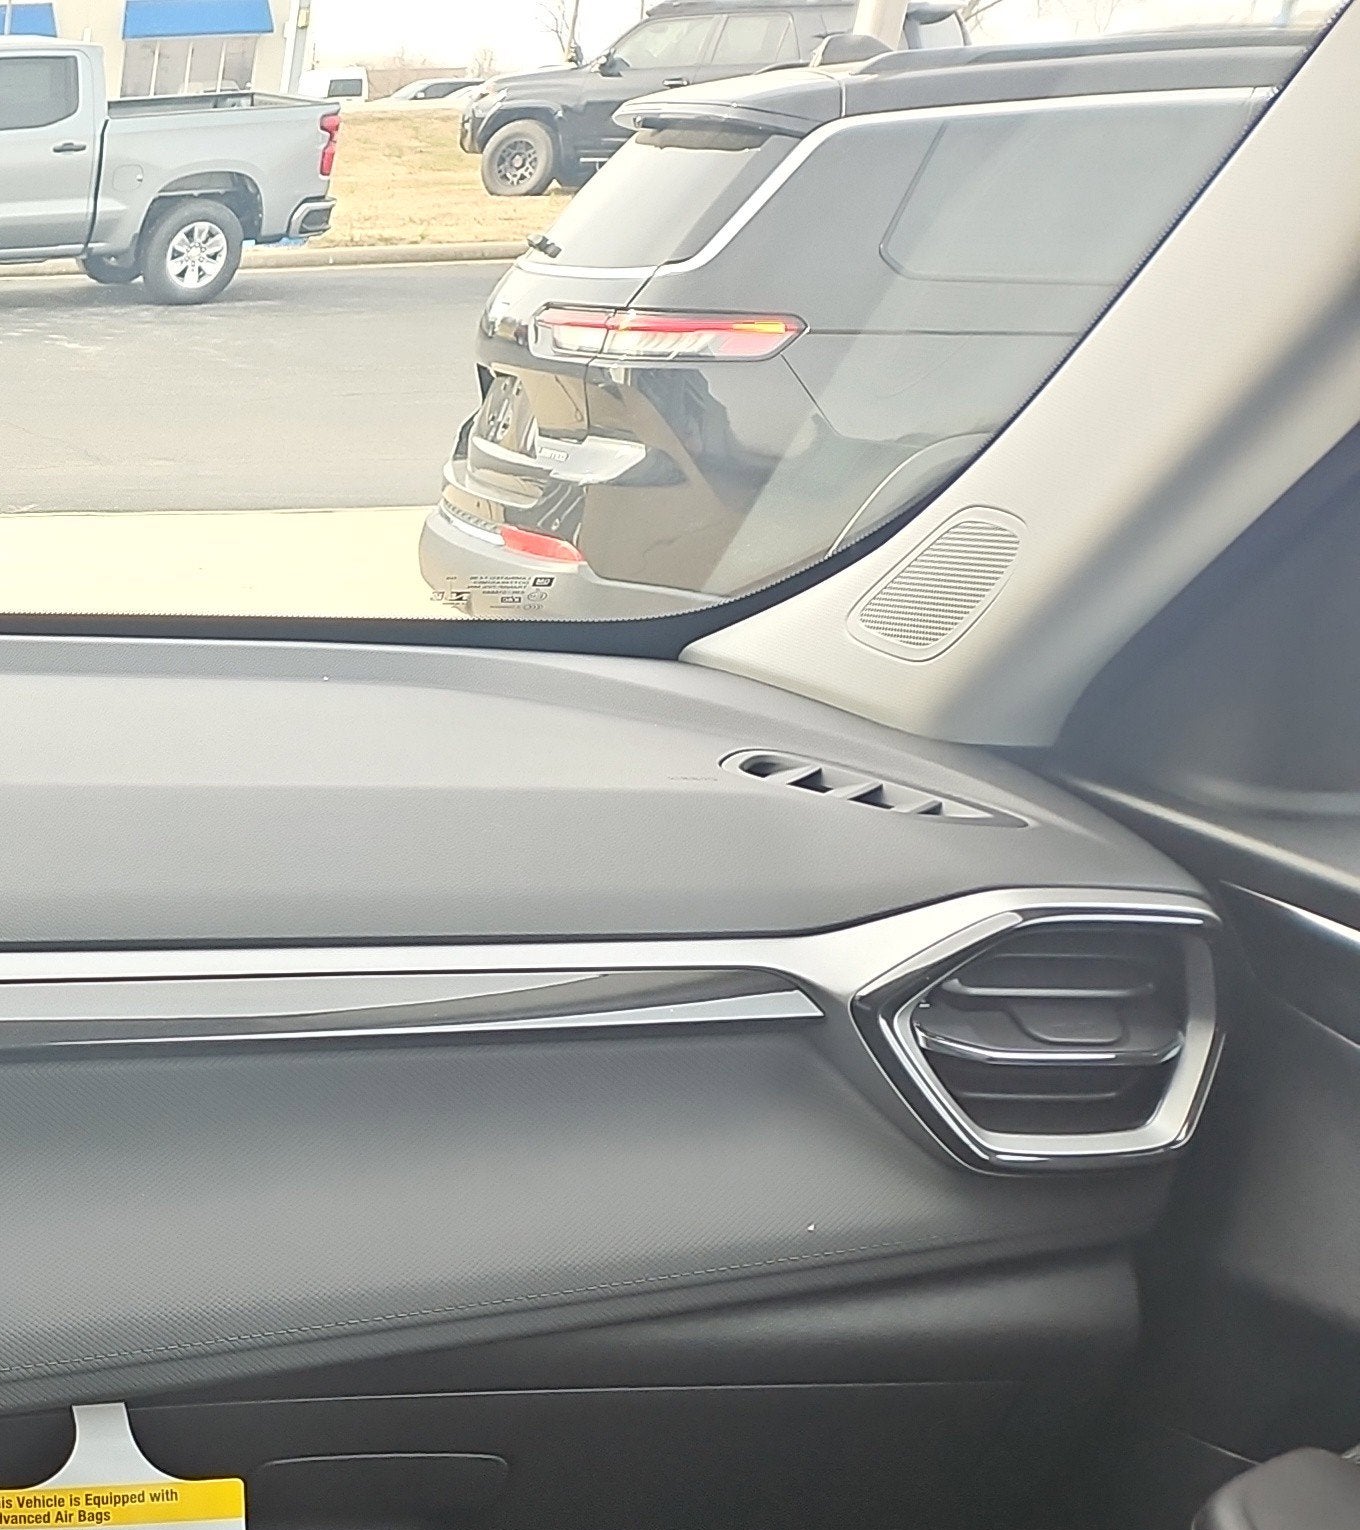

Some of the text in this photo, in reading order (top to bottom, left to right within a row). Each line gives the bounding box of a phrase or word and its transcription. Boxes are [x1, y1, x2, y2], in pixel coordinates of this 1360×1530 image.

[16, 1495, 65, 1509] Vehicle
[69, 1494, 81, 1507] is
[85, 1491, 145, 1508] Equipped
[149, 1489, 178, 1503] with
[55, 1510, 74, 1523] Air
[78, 1509, 111, 1525] Bags
